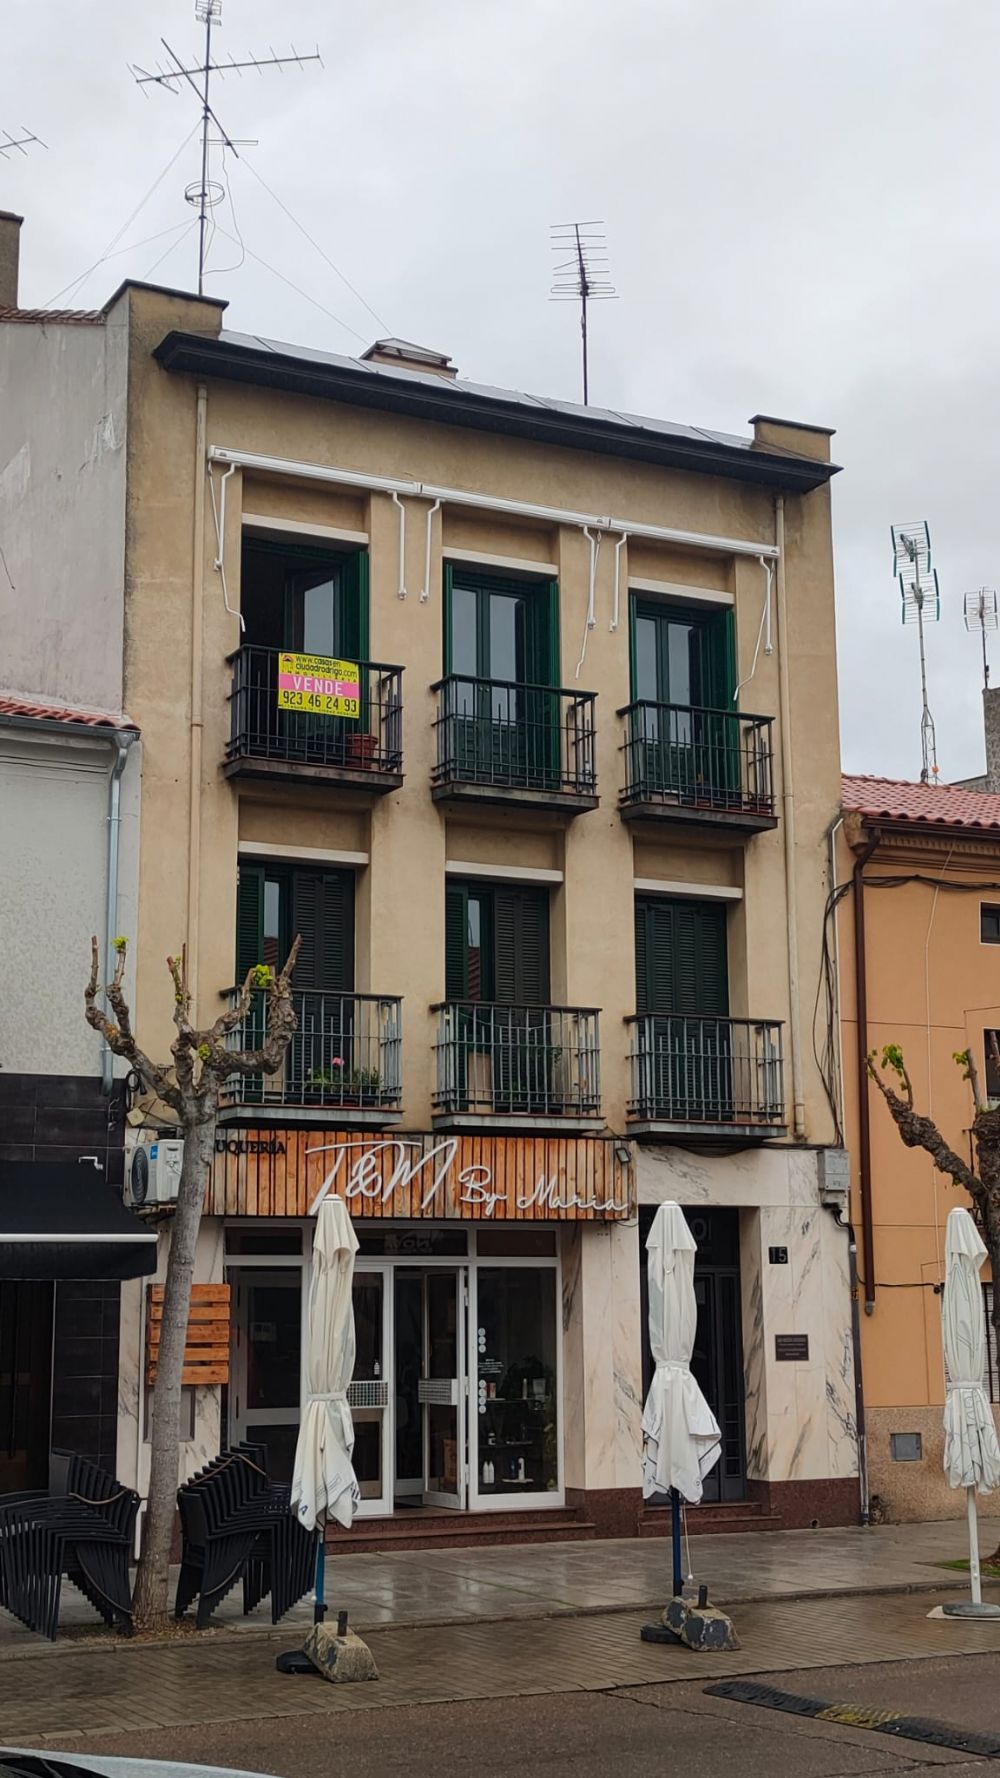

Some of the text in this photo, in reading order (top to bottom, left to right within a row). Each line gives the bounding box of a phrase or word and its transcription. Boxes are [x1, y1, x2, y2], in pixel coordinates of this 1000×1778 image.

[295, 663, 357, 677] ciudadrodrigo.com
[293, 676, 344, 696] VENDE
[283, 690, 303, 705] 923
[308, 693, 322, 707] 46
[326, 696, 339, 710] 24
[344, 698, 357, 712] 93
[215, 1138, 286, 1156] UQUERÍA
[458, 1165, 507, 1216] By
[517, 1175, 629, 1211] Maria
[770, 1247, 787, 1263] 15
